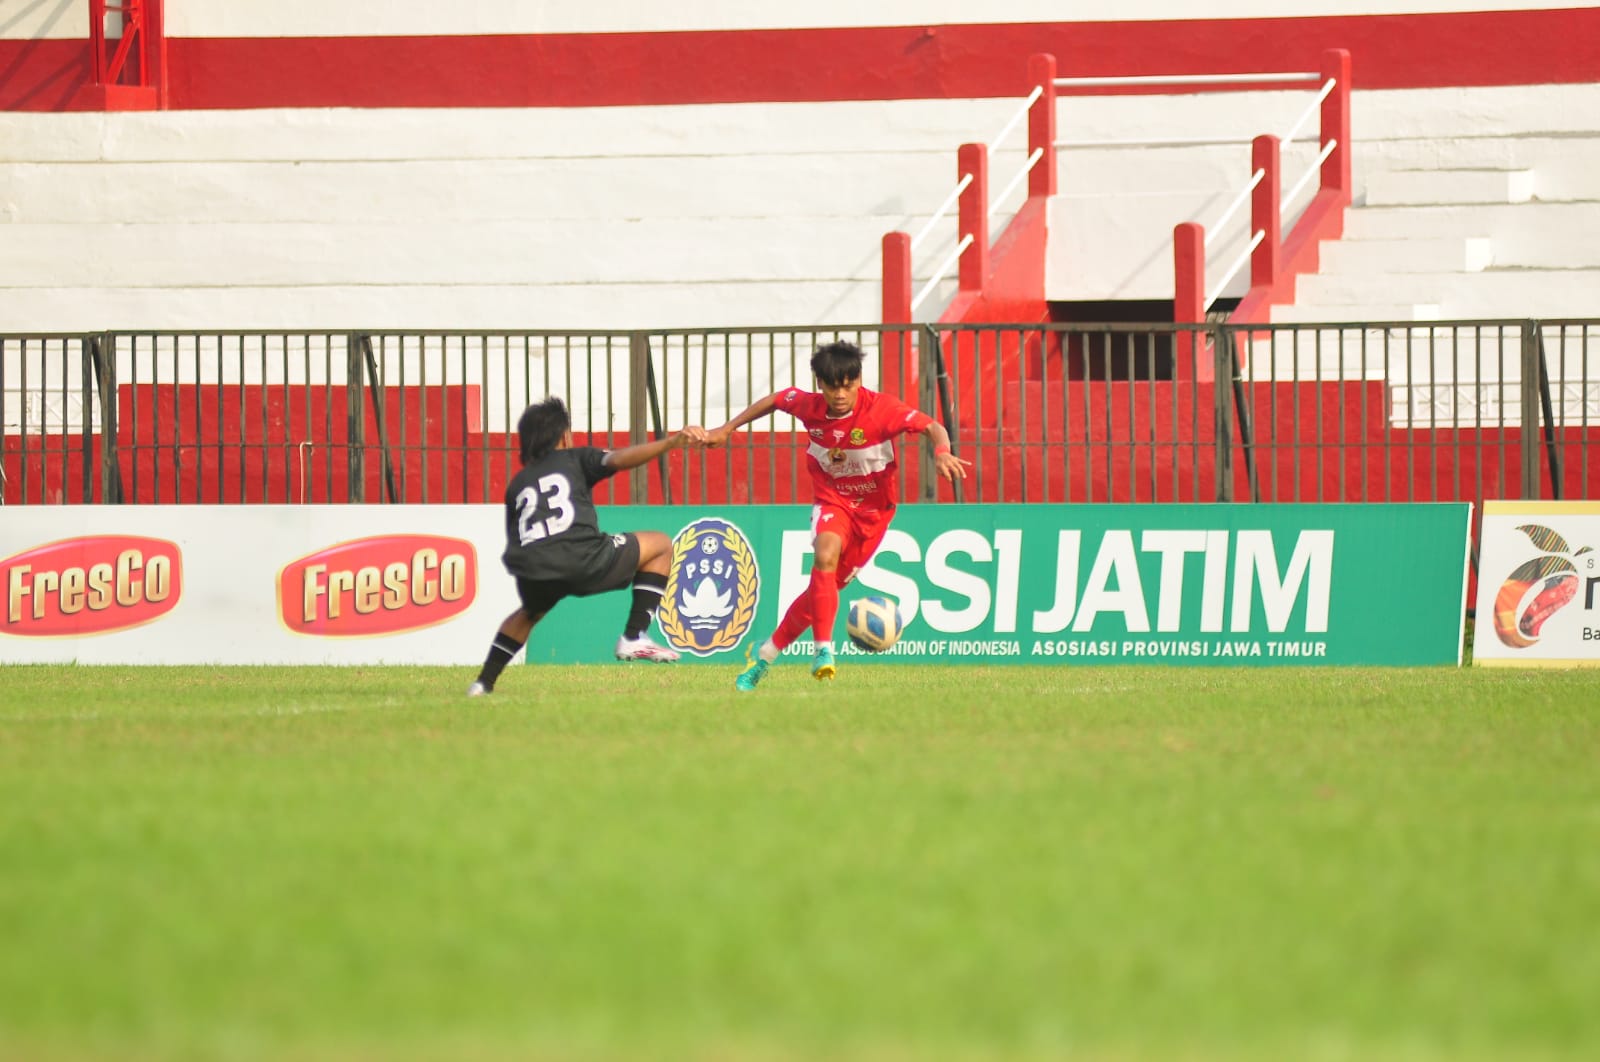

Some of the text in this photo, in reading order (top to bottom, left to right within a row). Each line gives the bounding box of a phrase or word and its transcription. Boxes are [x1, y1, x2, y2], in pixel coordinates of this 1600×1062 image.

[515, 472, 575, 547] 23
[9, 548, 171, 624] FresCo
[303, 547, 466, 624] FresCo
[685, 558, 733, 579] PSSI
[1032, 529, 1335, 633] JATIM
[781, 640, 839, 656] OOTBL
[928, 640, 947, 656] OF
[948, 640, 1021, 656] INDONESIA
[1032, 640, 1116, 656] ASOSIASI
[1122, 640, 1209, 656] PROVINSI
[1212, 640, 1262, 656] JAWA
[1266, 641, 1327, 656] TIMUR
